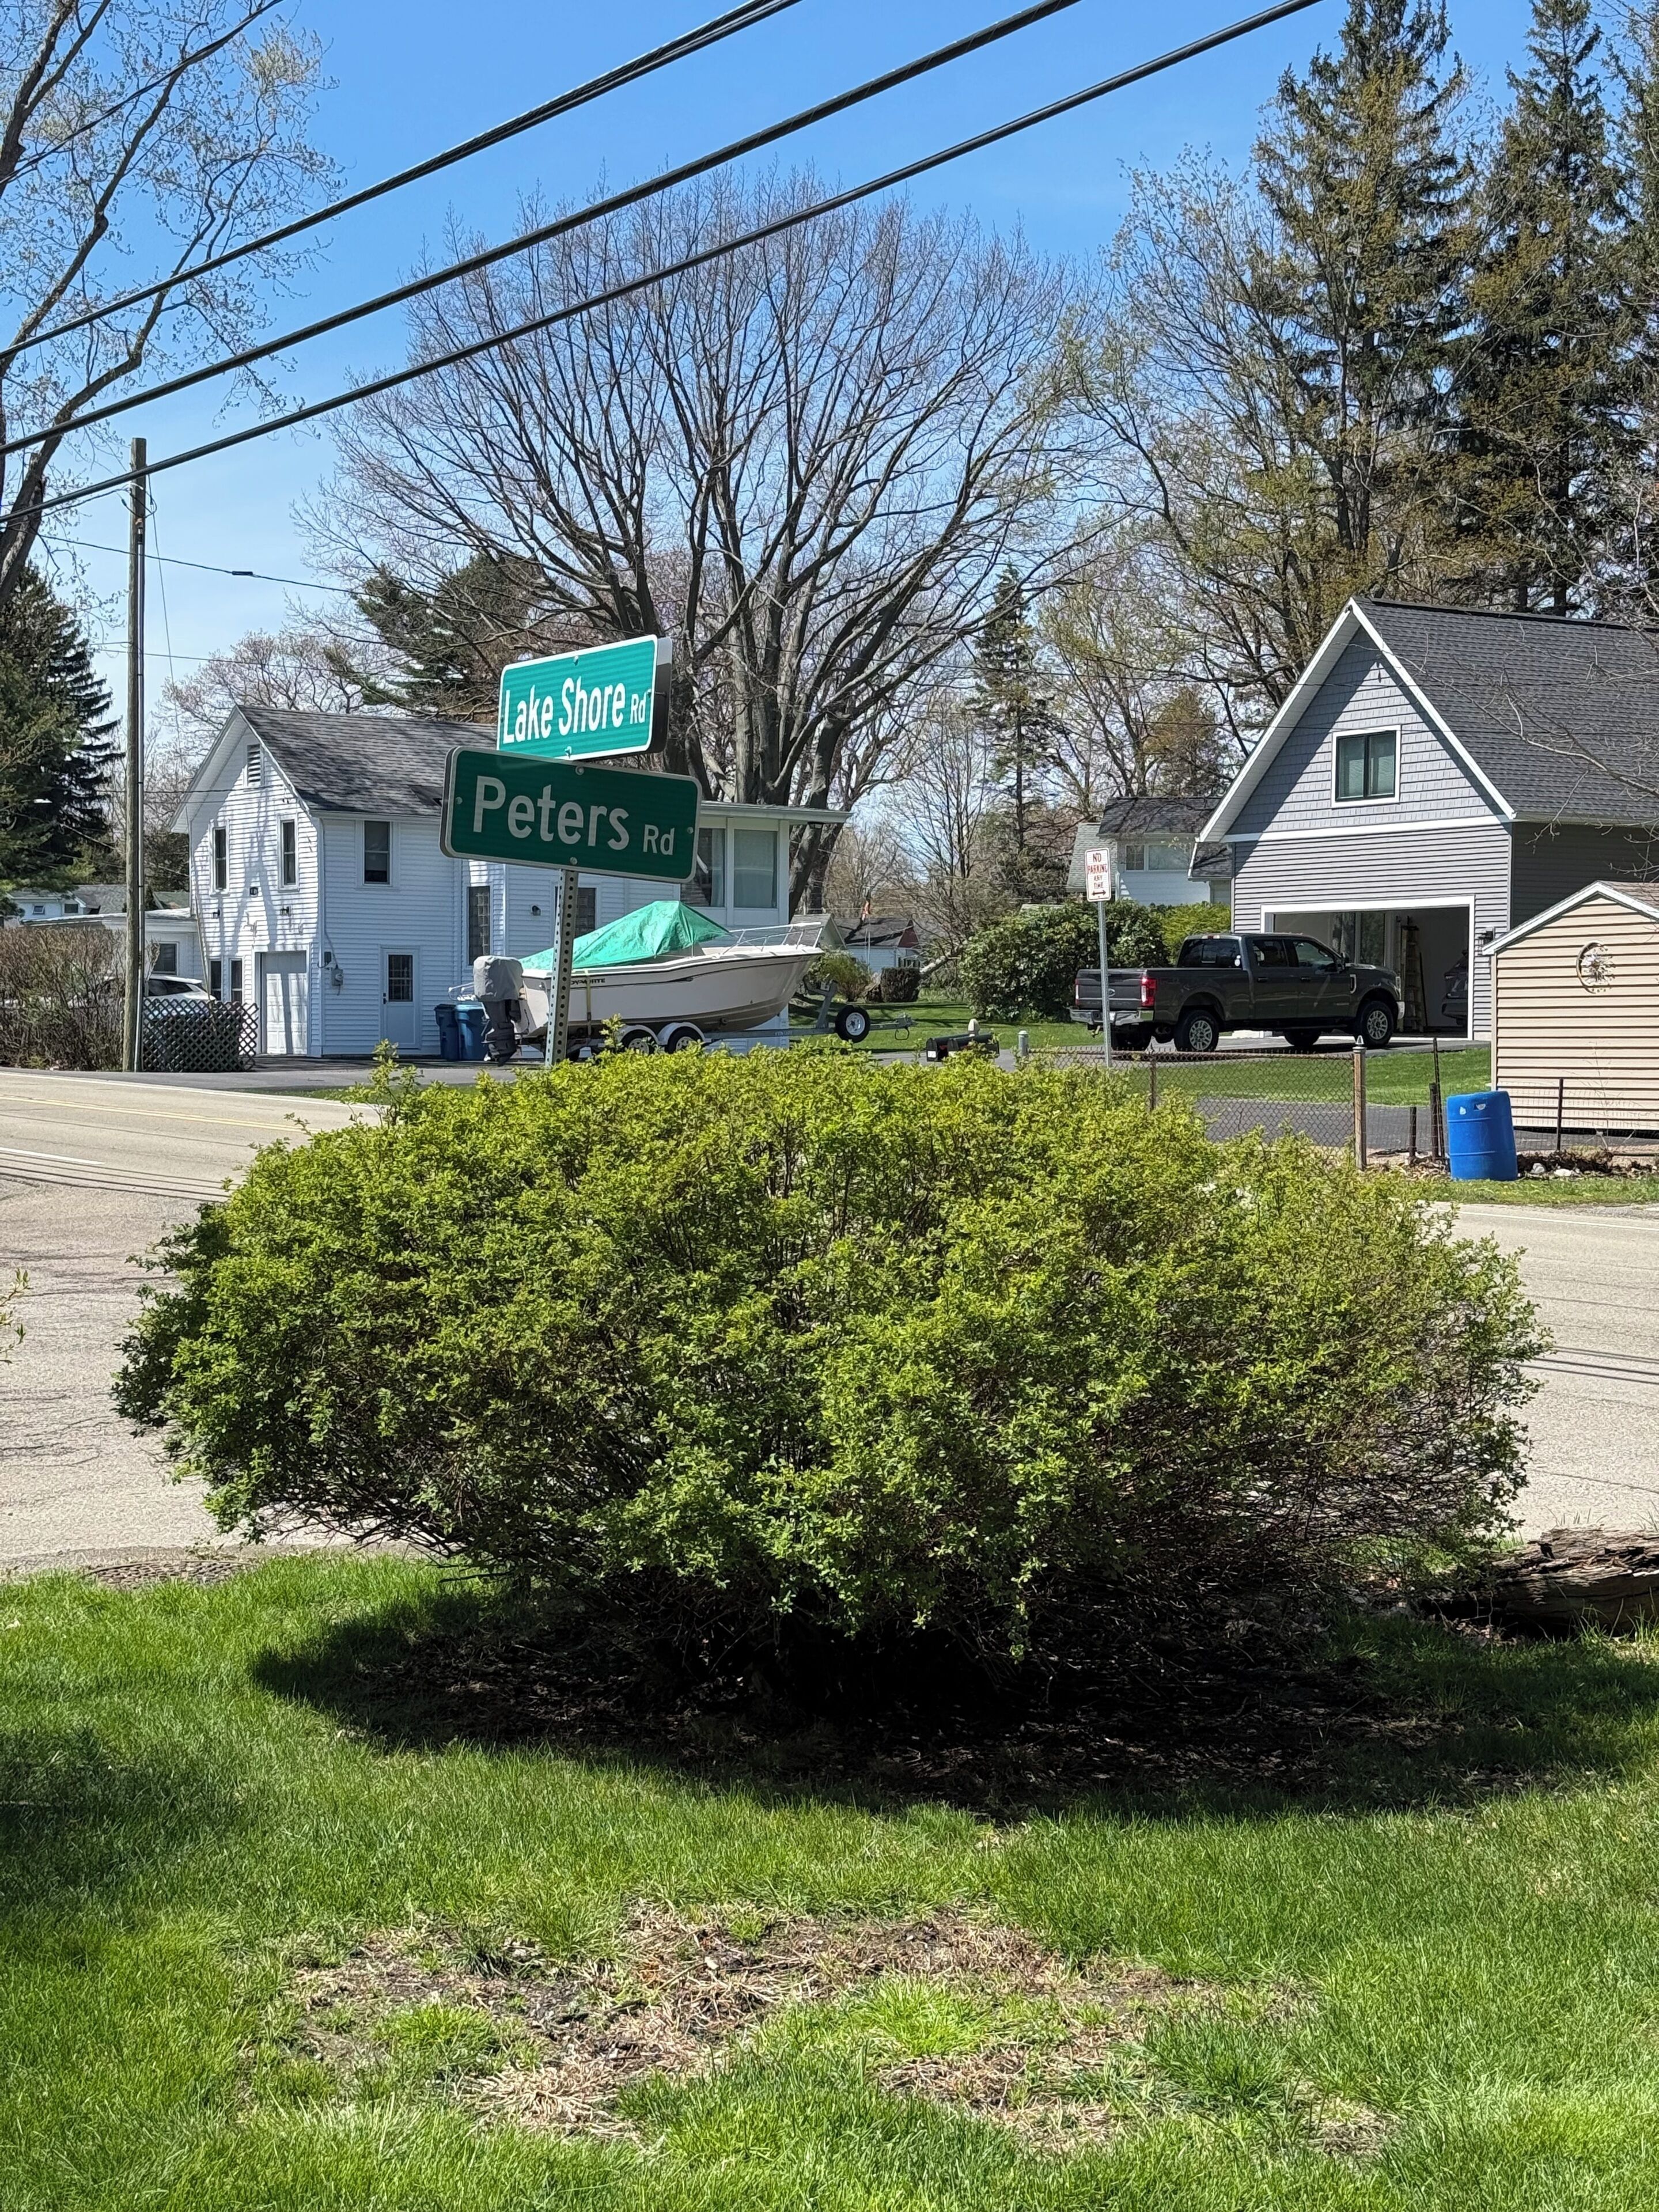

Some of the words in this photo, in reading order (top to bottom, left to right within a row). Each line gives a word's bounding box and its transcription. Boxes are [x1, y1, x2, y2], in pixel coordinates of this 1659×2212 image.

[503, 685, 554, 744] Lake
[558, 676, 626, 736] Shore
[630, 692, 646, 725] Rd
[473, 775, 630, 850] Peters
[643, 824, 675, 855] Rd
[1088, 864, 1107, 874] PARKING
[1093, 853, 1101, 862] NO
